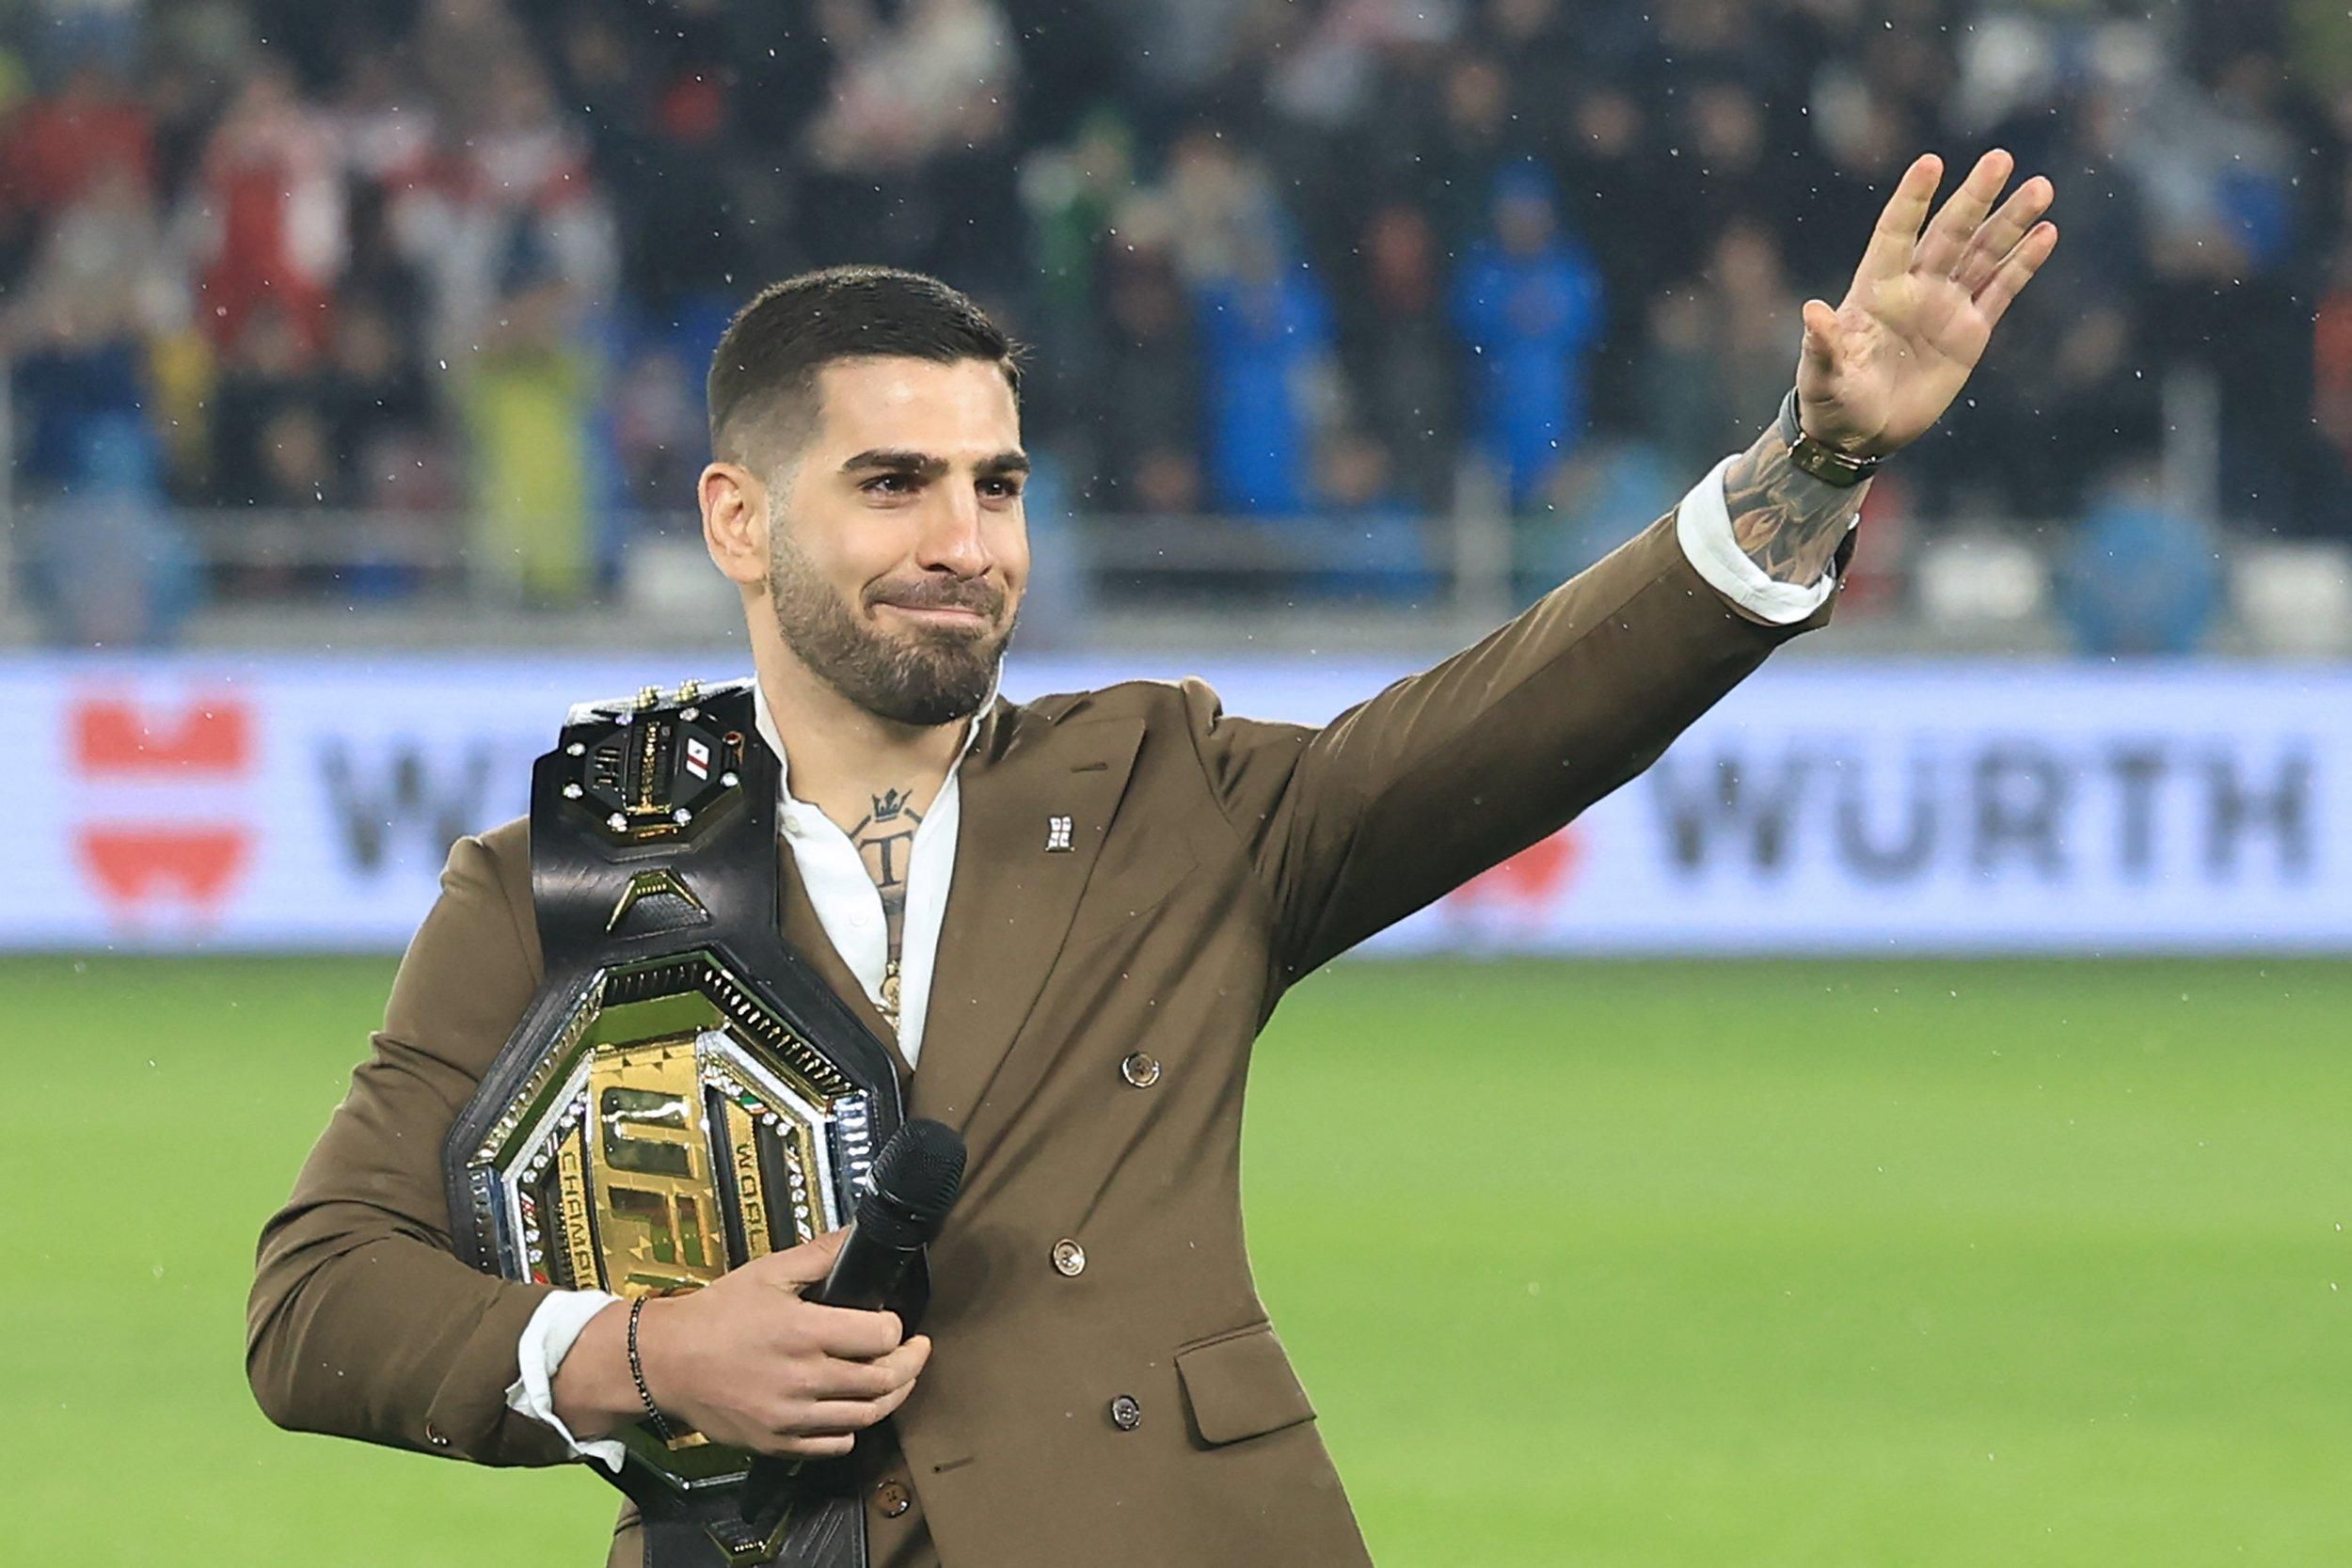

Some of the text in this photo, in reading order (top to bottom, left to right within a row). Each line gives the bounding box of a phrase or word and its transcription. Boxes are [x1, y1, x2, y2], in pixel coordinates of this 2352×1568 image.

[562, 1150, 594, 1291] CHAMPI
[600, 1085, 712, 1291] UF
[737, 1143, 764, 1253] WORL
